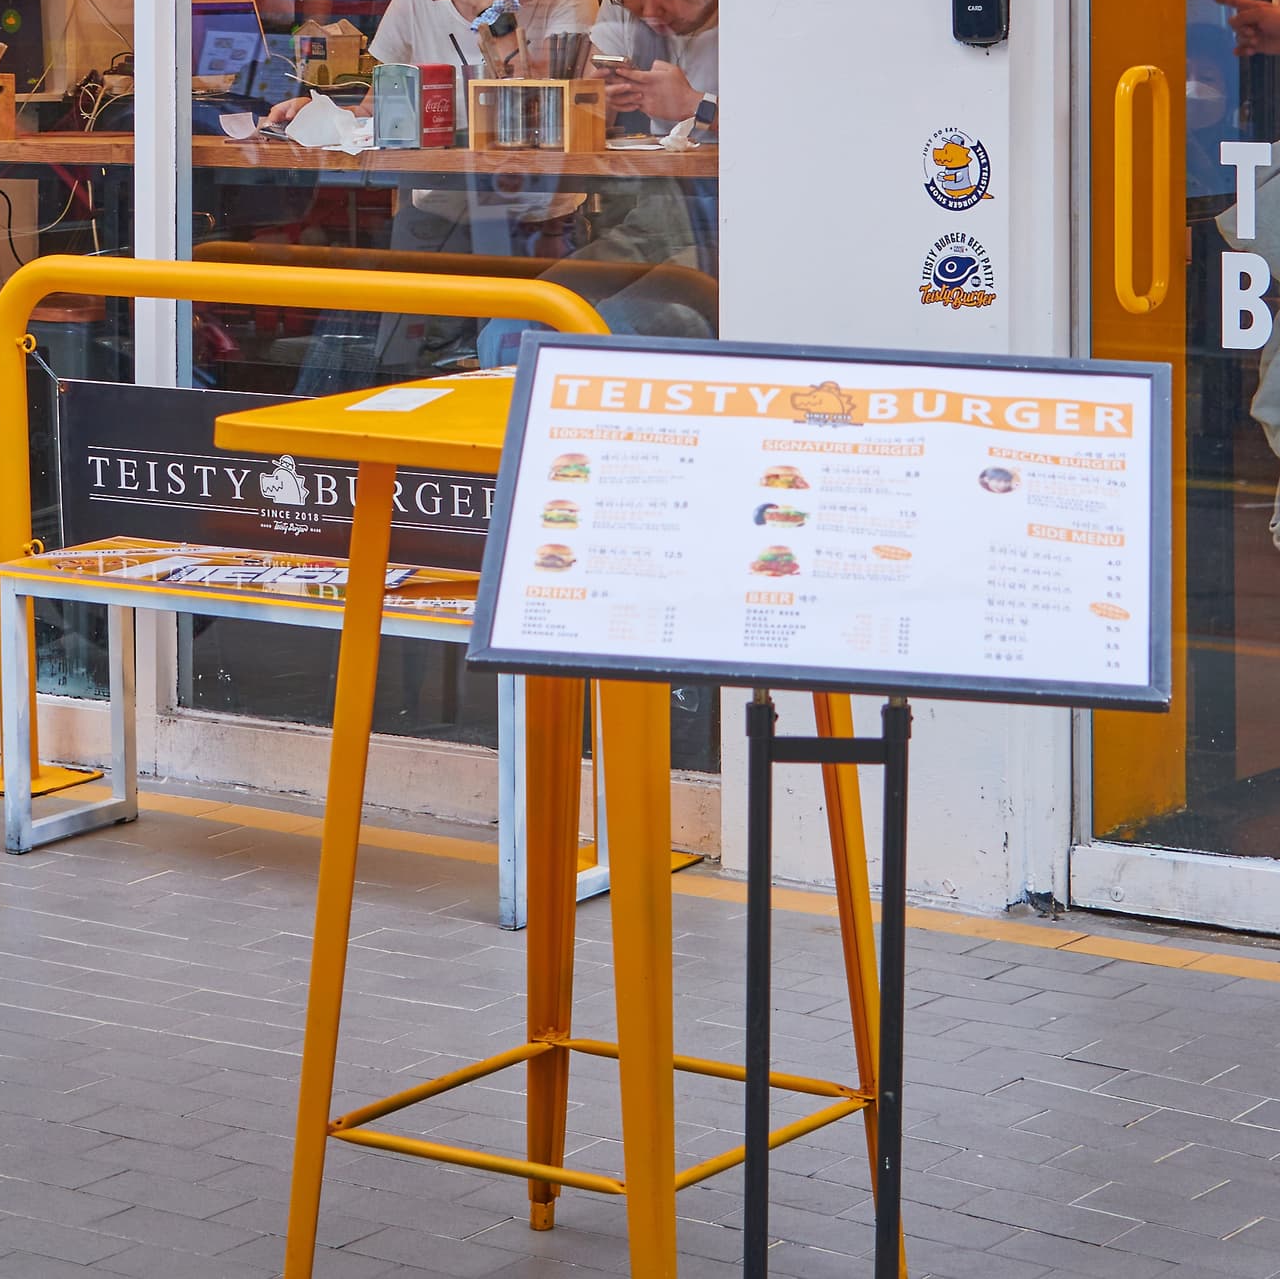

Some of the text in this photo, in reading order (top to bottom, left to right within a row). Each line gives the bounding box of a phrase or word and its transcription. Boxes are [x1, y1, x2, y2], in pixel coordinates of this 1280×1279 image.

[976, 147, 987, 164] THE
[922, 232, 994, 289] TEISTY BURGER BEEF PATTY
[951, 286, 997, 310] Burger
[559, 379, 1128, 433] TEISTY BURGER
[633, 432, 698, 446] BURGER
[764, 440, 922, 457] SIGNATURE BURGER
[992, 448, 1123, 470] SPECIAL BURGER
[88, 456, 252, 500] TEISTY
[260, 509, 320, 521] SINCE 2018
[1031, 525, 1121, 546] SIDE MENU
[527, 586, 586, 600] DRINK
[748, 593, 793, 604] BEER
